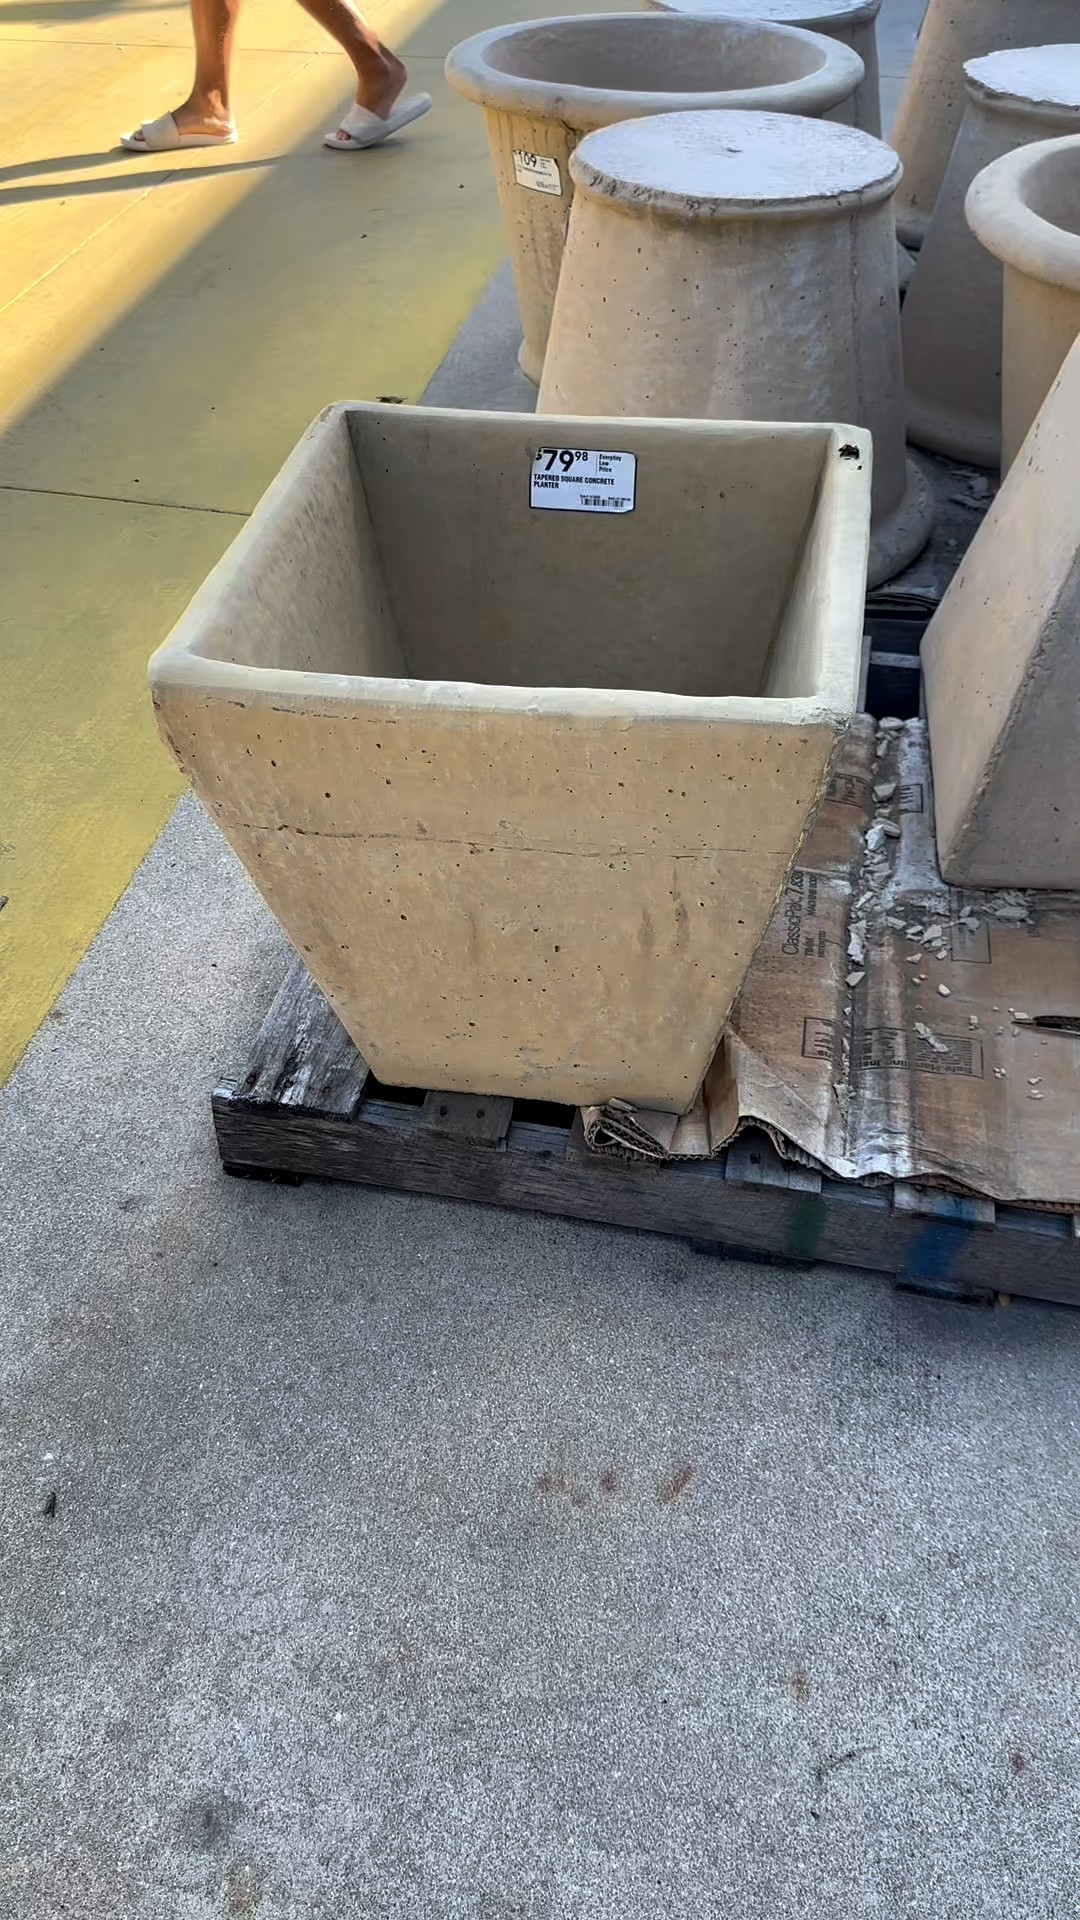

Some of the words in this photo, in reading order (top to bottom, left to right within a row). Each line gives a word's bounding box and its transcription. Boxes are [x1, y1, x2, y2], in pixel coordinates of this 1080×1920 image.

[599, 453, 622, 462] Everyday
[533, 473, 560, 482] TAPERED
[560, 475, 583, 484] SQUARE
[584, 477, 615, 486] CONCRETE
[533, 481, 560, 489] PLANTER
